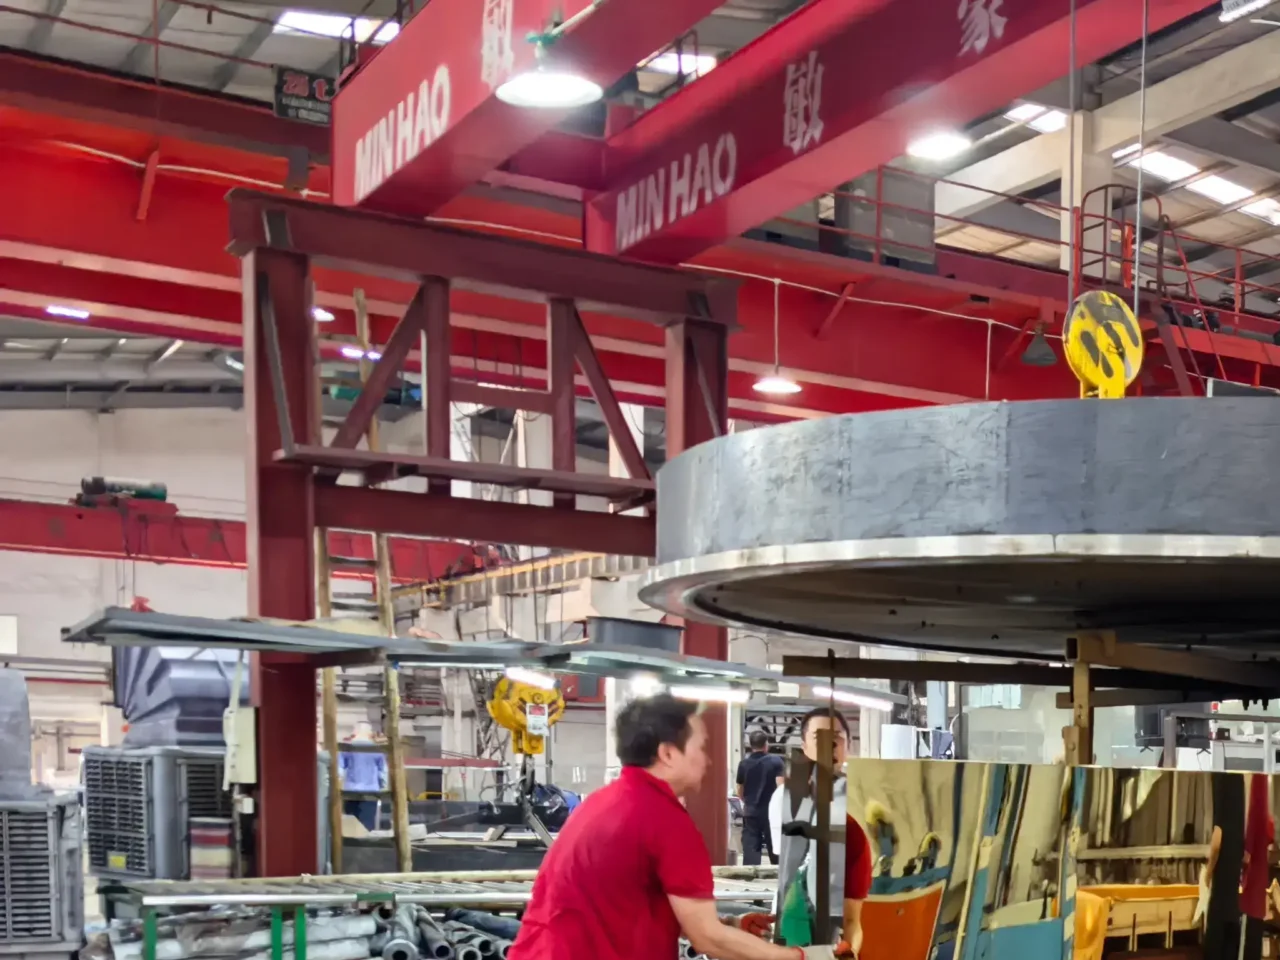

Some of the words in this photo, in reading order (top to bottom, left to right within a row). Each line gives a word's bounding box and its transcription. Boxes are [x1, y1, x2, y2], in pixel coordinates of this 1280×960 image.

[354, 109, 395, 205] MIN
[396, 61, 451, 170] HAO
[615, 167, 665, 251] MIN
[668, 132, 737, 224] HAO
